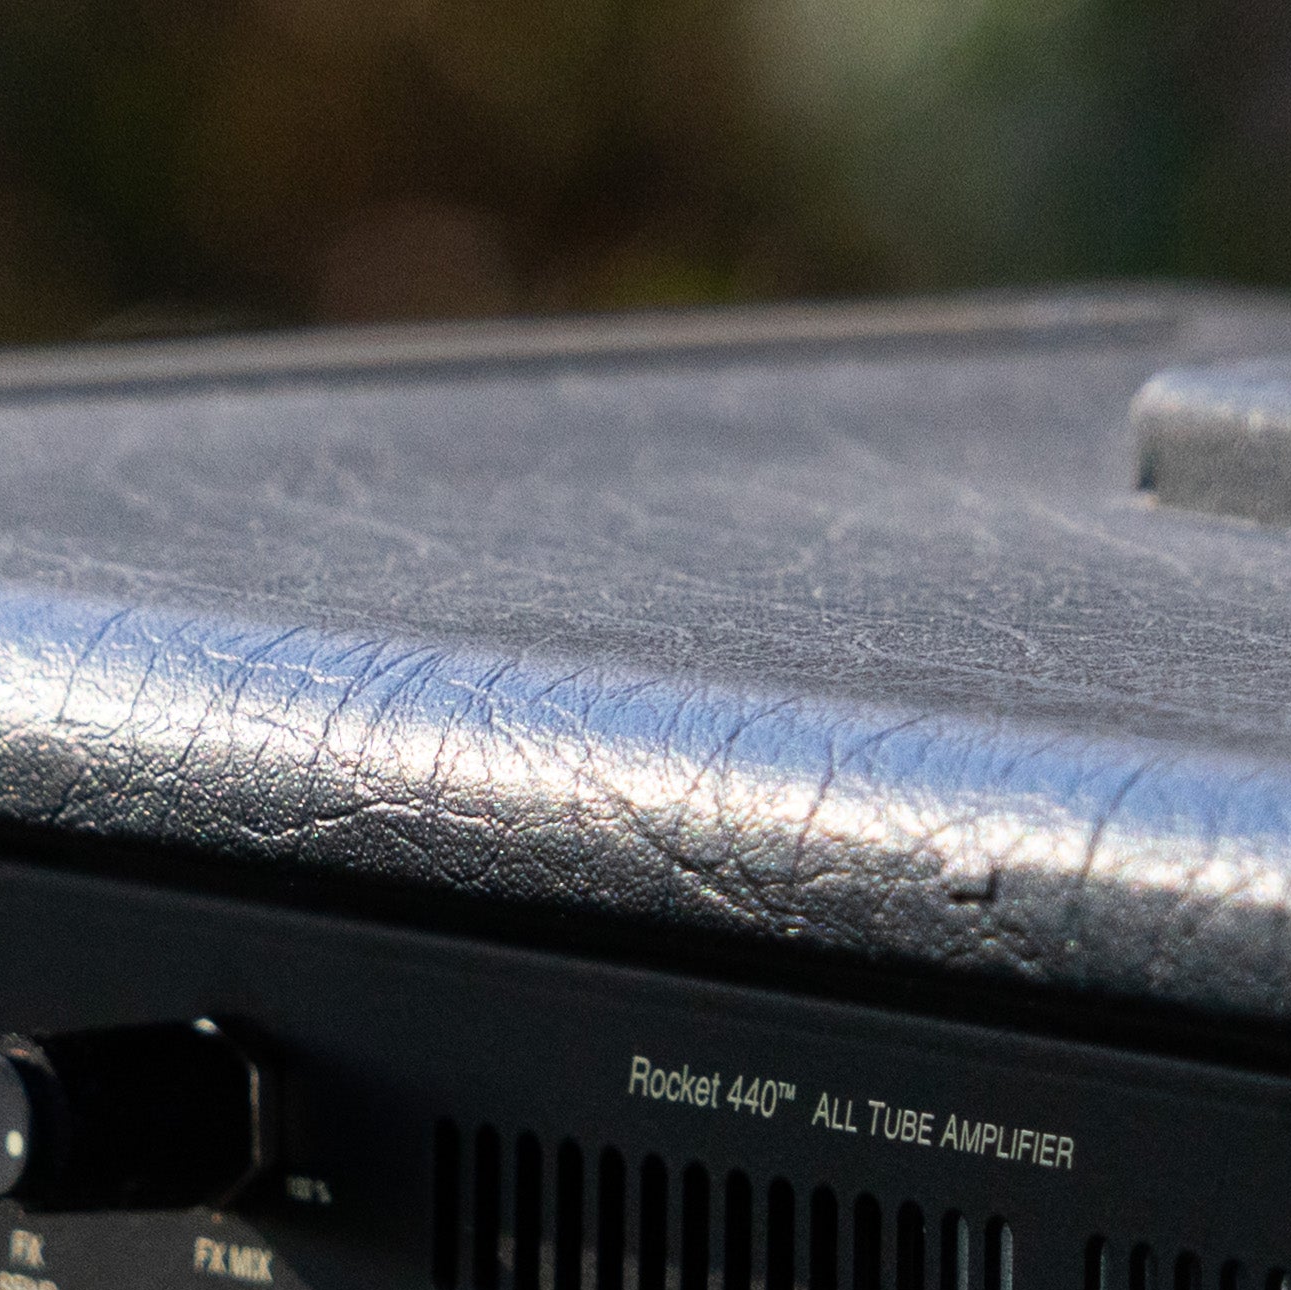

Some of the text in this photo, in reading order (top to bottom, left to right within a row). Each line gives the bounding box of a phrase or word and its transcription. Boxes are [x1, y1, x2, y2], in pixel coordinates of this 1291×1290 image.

[628, 1056, 721, 1109] Rocket
[811, 1092, 858, 1134] ALL
[868, 1100, 935, 1147] TUBE
[939, 1114, 1075, 1170] AMPLIFIER
[10, 1229, 45, 1270] FX
[193, 1236, 274, 1286] FX MIX
